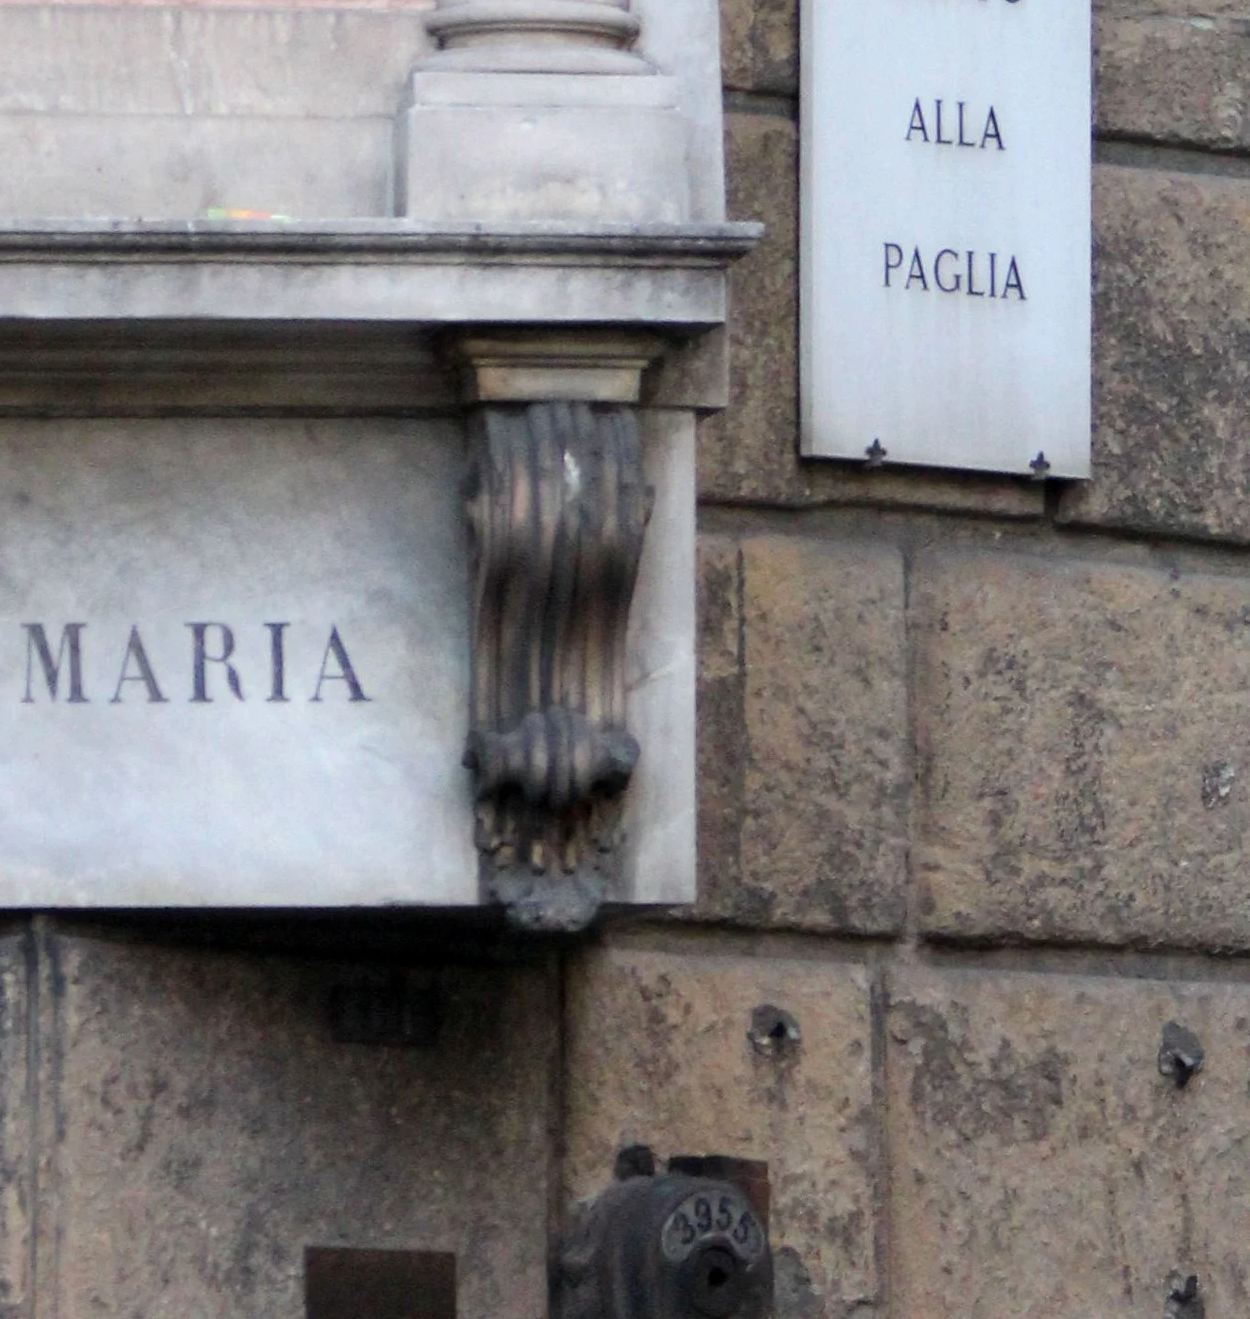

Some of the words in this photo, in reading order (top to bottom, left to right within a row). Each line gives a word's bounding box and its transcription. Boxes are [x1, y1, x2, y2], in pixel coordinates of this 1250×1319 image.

[905, 97, 1006, 150] ALLA
[883, 243, 1027, 300] PAGLIA
[20, 622, 372, 704] MARIA
